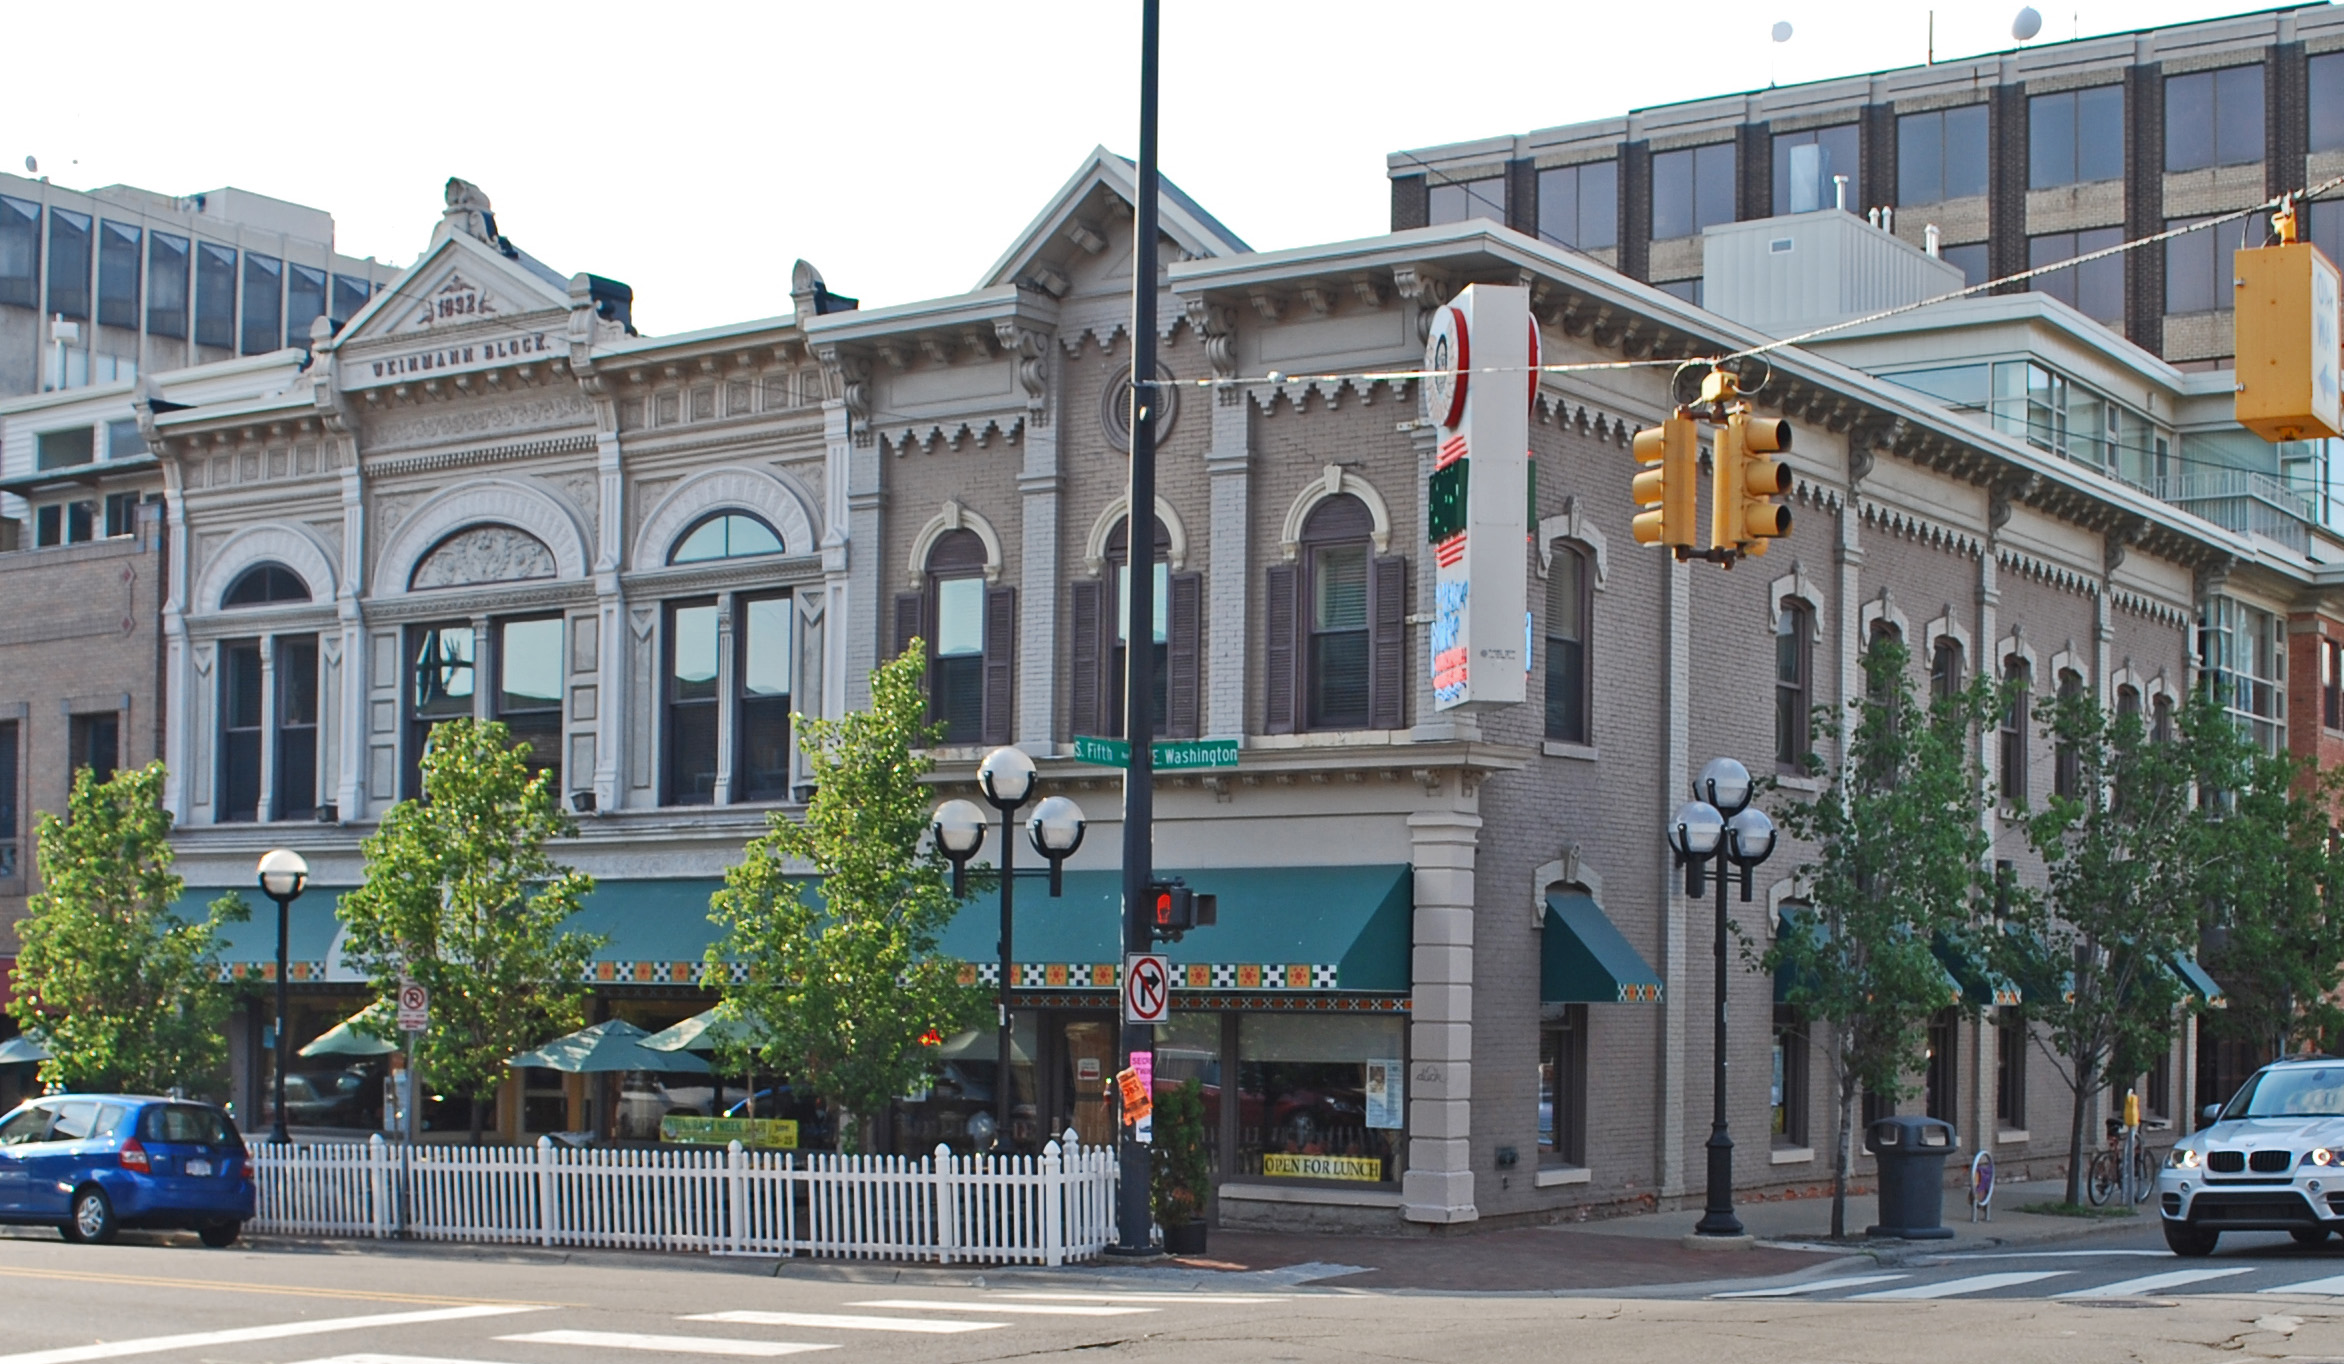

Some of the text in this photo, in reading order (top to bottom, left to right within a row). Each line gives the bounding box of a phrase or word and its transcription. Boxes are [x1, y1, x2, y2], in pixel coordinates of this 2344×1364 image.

[372, 332, 551, 378] WEINMANN BLOCK.
[1074, 740, 1085, 758] S.
[1087, 742, 1113, 761] Fifth
[1165, 746, 1238, 767] Washington
[1264, 1157, 1379, 1178] OPEN FOR LUNCH
